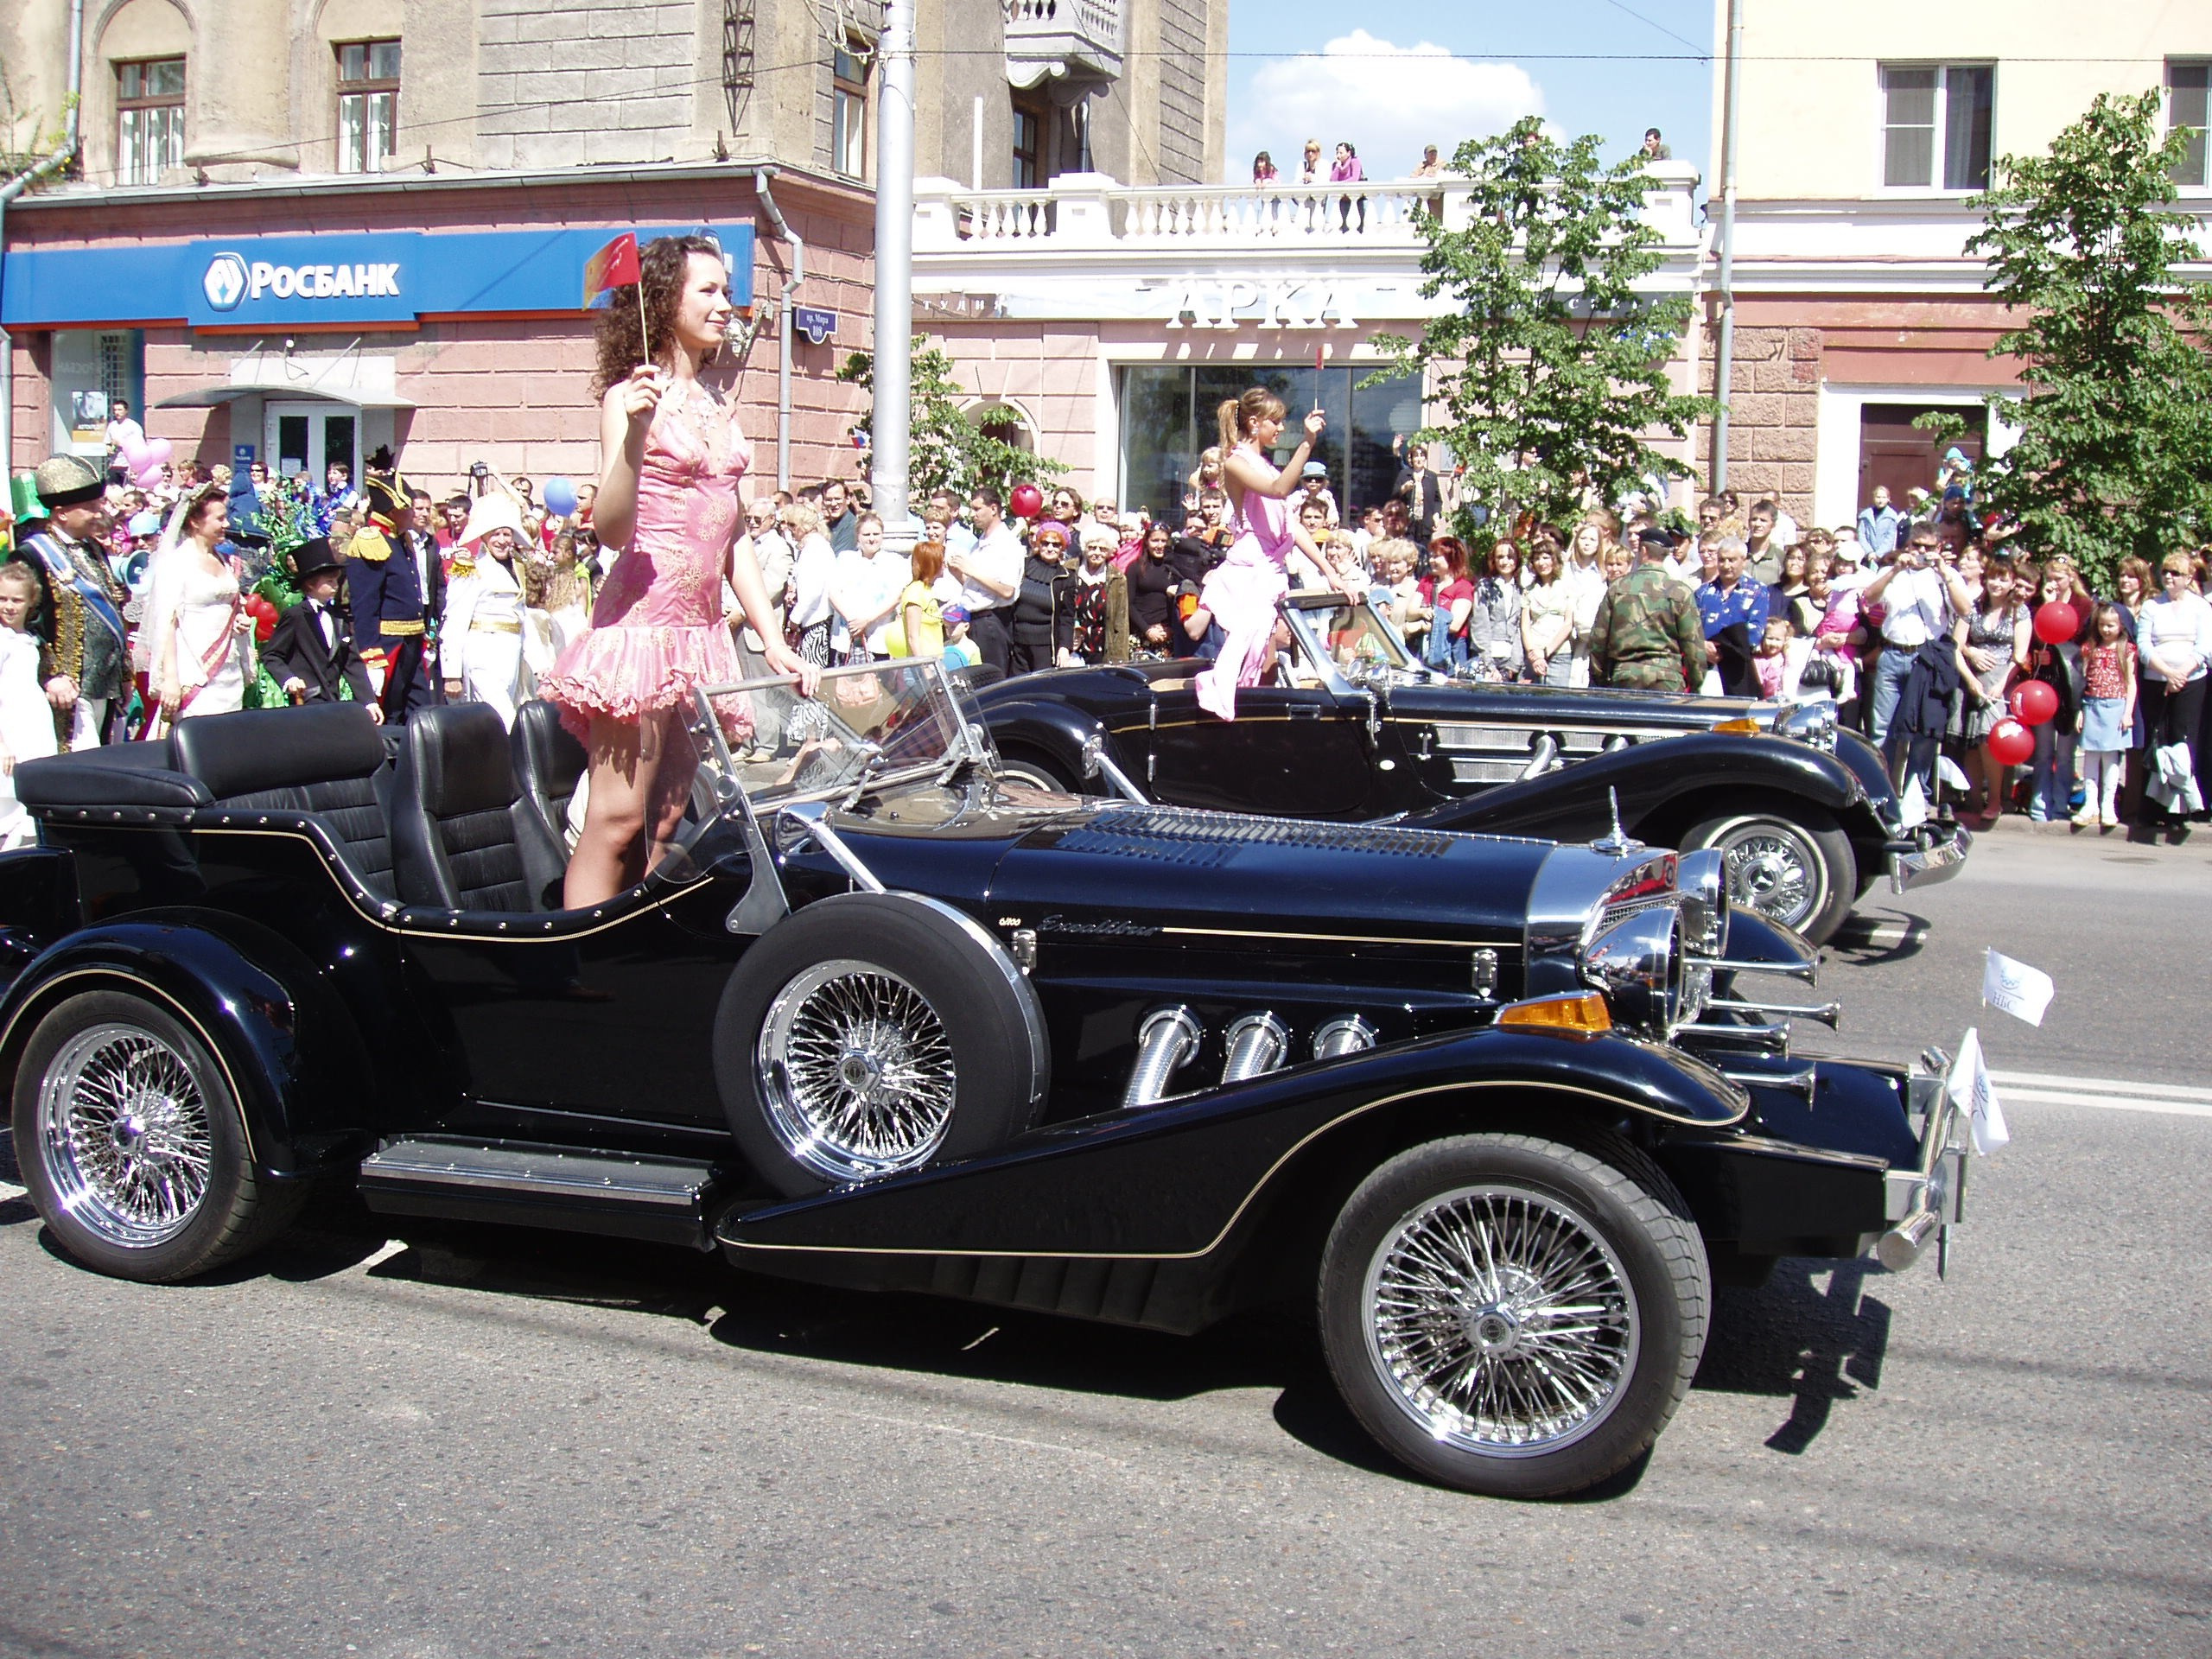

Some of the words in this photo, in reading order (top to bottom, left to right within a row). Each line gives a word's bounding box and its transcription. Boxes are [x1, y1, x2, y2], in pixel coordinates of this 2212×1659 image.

[251, 262, 400, 300] РОСБАНК
[911, 299, 1003, 311] ТУДИЯ
[1166, 272, 1359, 328] АРКА
[812, 325, 823, 337] 108
